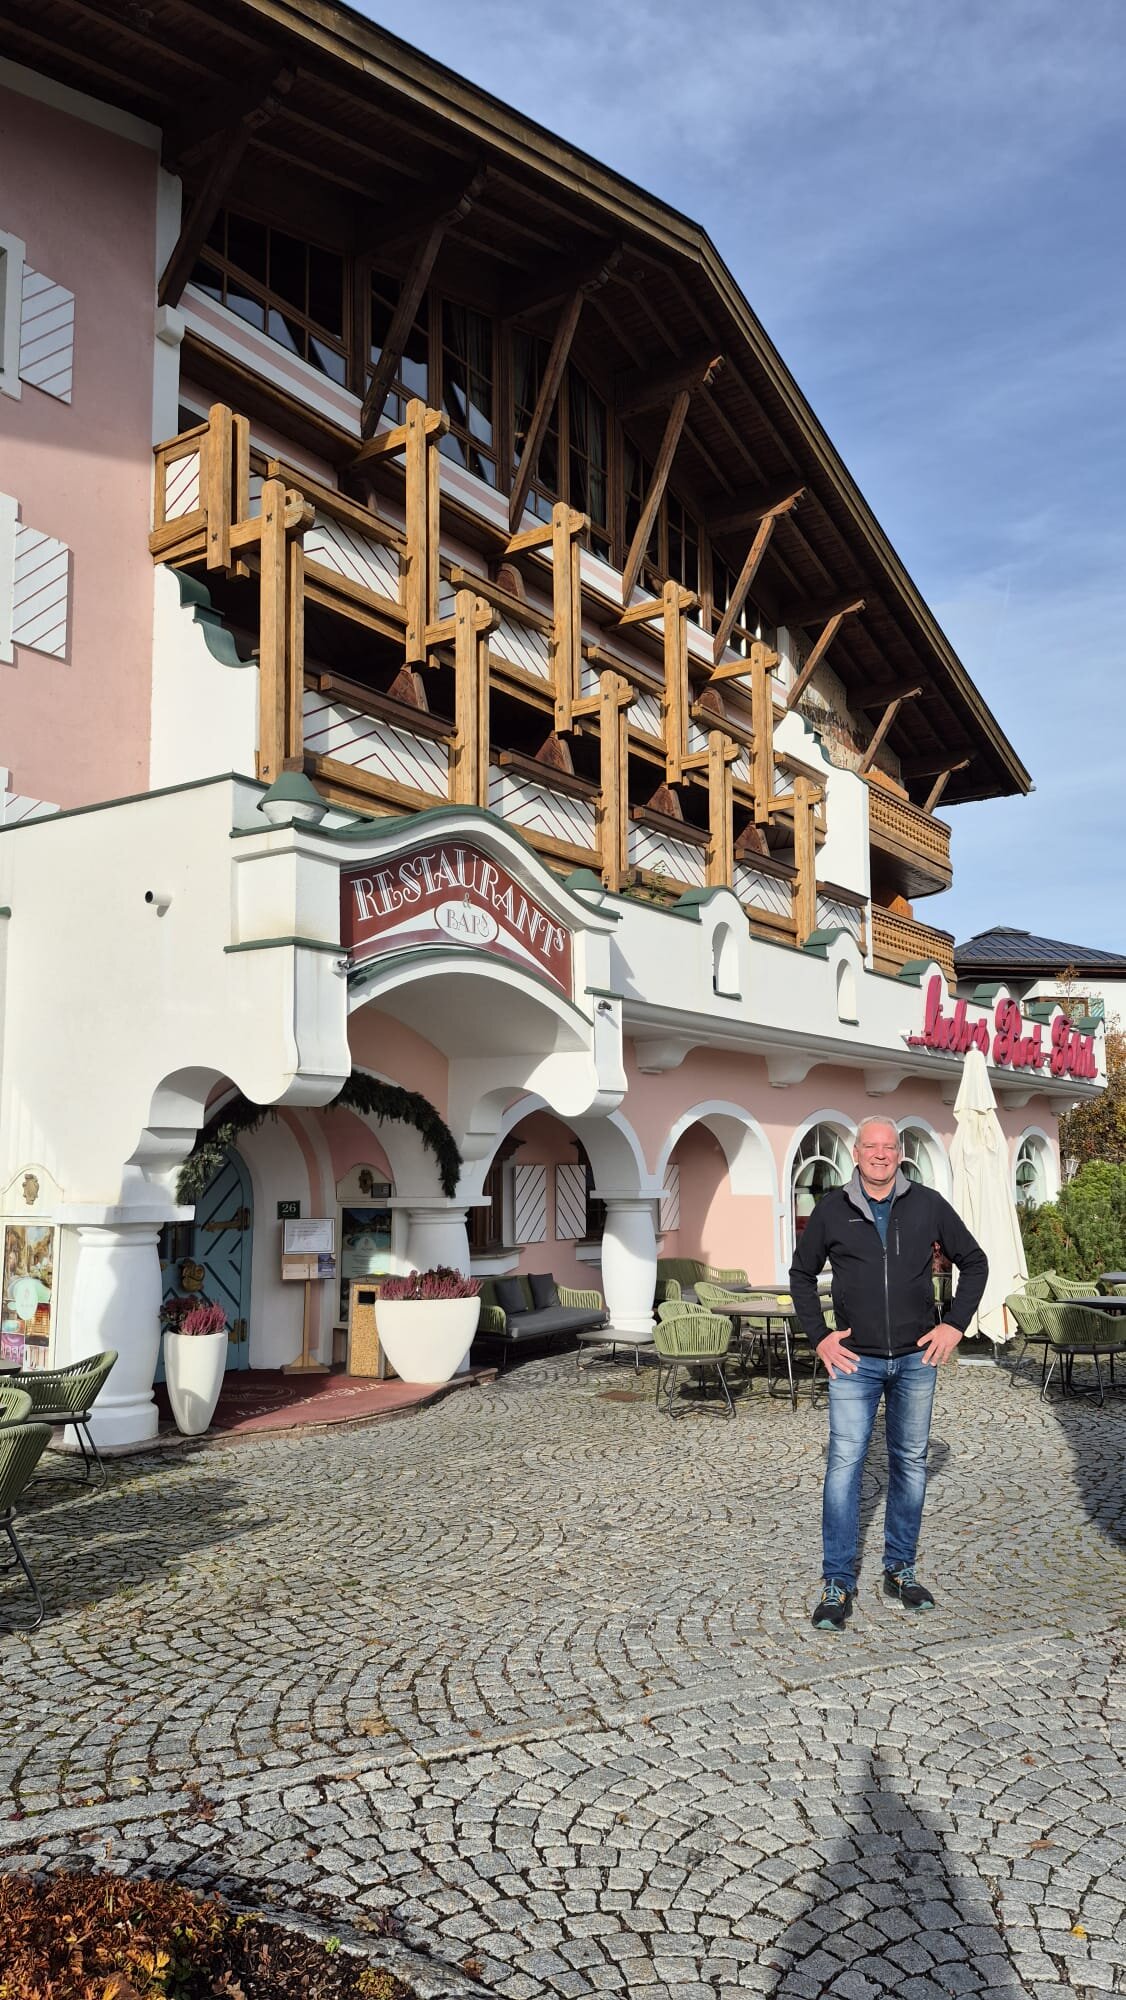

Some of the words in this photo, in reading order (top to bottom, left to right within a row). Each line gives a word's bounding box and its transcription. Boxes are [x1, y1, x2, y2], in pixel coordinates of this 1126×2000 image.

[350, 849, 566, 957] RESTAURANTS
[462, 892, 472, 909] &
[446, 908, 491, 938] BARS
[281, 1203, 297, 1213] 26
